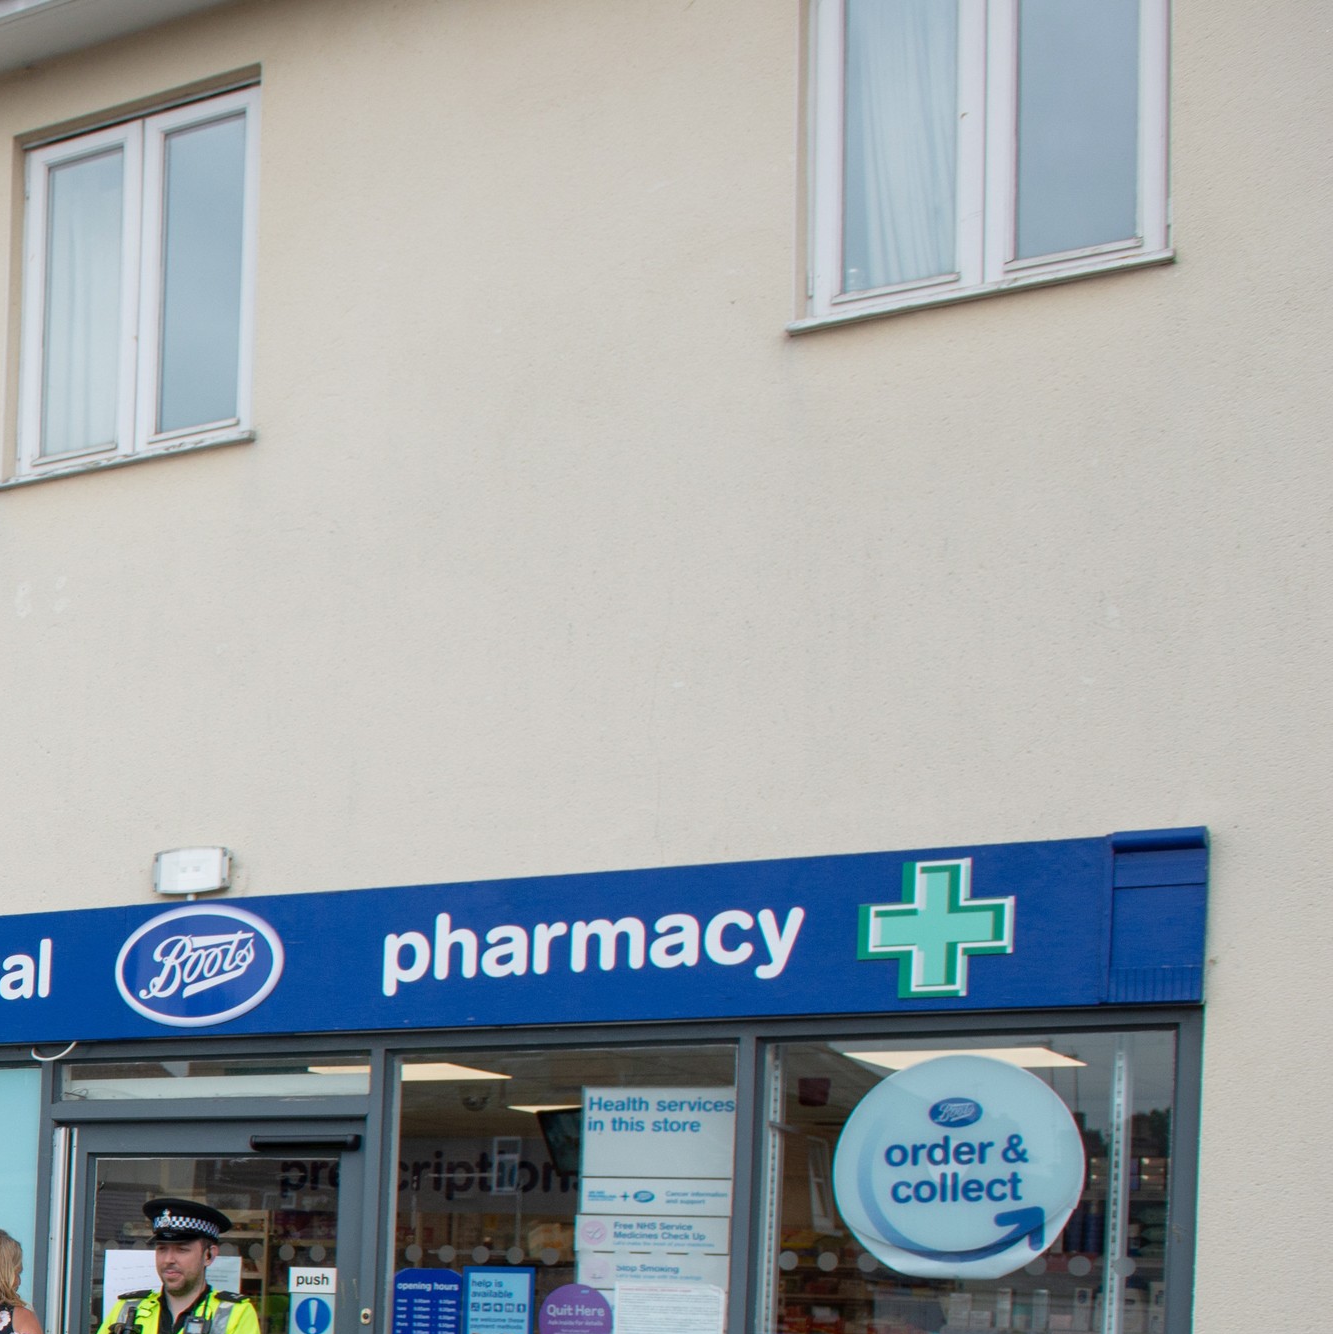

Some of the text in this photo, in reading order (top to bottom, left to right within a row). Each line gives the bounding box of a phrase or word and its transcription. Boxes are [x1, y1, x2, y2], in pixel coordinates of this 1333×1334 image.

[382, 906, 805, 997] pharmacy
[139, 929, 256, 1000] Boots
[588, 1096, 735, 1112] Health services
[938, 1101, 976, 1121] Boots
[588, 1117, 701, 1132] in this store
[884, 1134, 1028, 1168] order &
[890, 1171, 1022, 1205] collect
[614, 1222, 692, 1231] Free NHS Service
[613, 1232, 706, 1241] Medicines Check Up
[616, 1265, 679, 1273] Stop Smoking
[296, 1273, 330, 1287] push
[397, 1282, 459, 1291] opening hours
[471, 1280, 492, 1288] help
[471, 1290, 513, 1298] available
[547, 1305, 605, 1317] Quit Here
